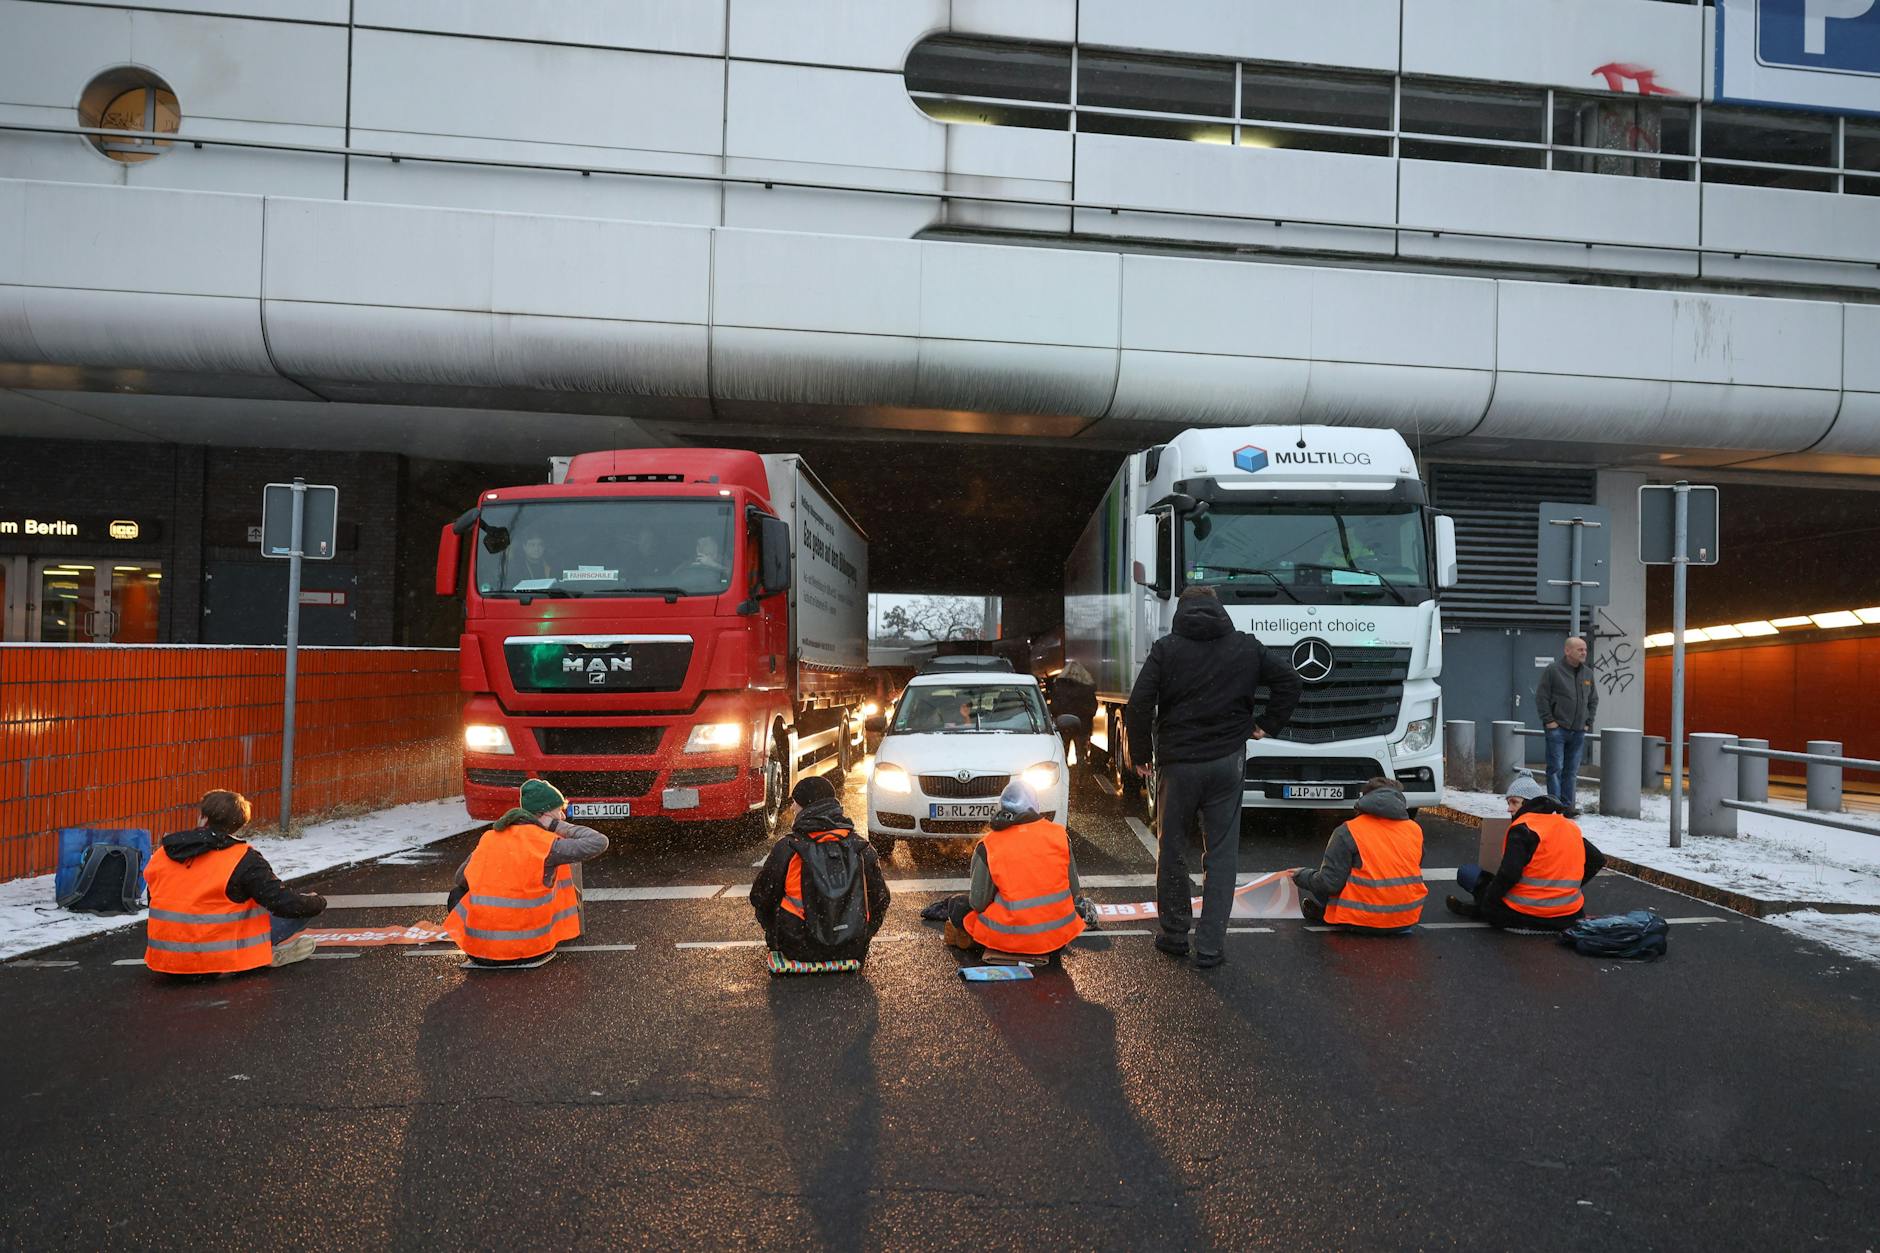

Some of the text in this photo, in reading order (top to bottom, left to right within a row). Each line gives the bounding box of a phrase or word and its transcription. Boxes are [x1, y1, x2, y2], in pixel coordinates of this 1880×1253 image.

[1275, 452, 1371, 465] MULTILOG
[24, 519, 78, 536] Berlin
[1251, 618, 1376, 634] Intelligent choice
[562, 657, 633, 672] MAN
[1290, 787, 1343, 798] LIP VT 26
[587, 805, 600, 815] EV
[603, 804, 629, 815] 1000
[952, 805, 967, 817] RL
